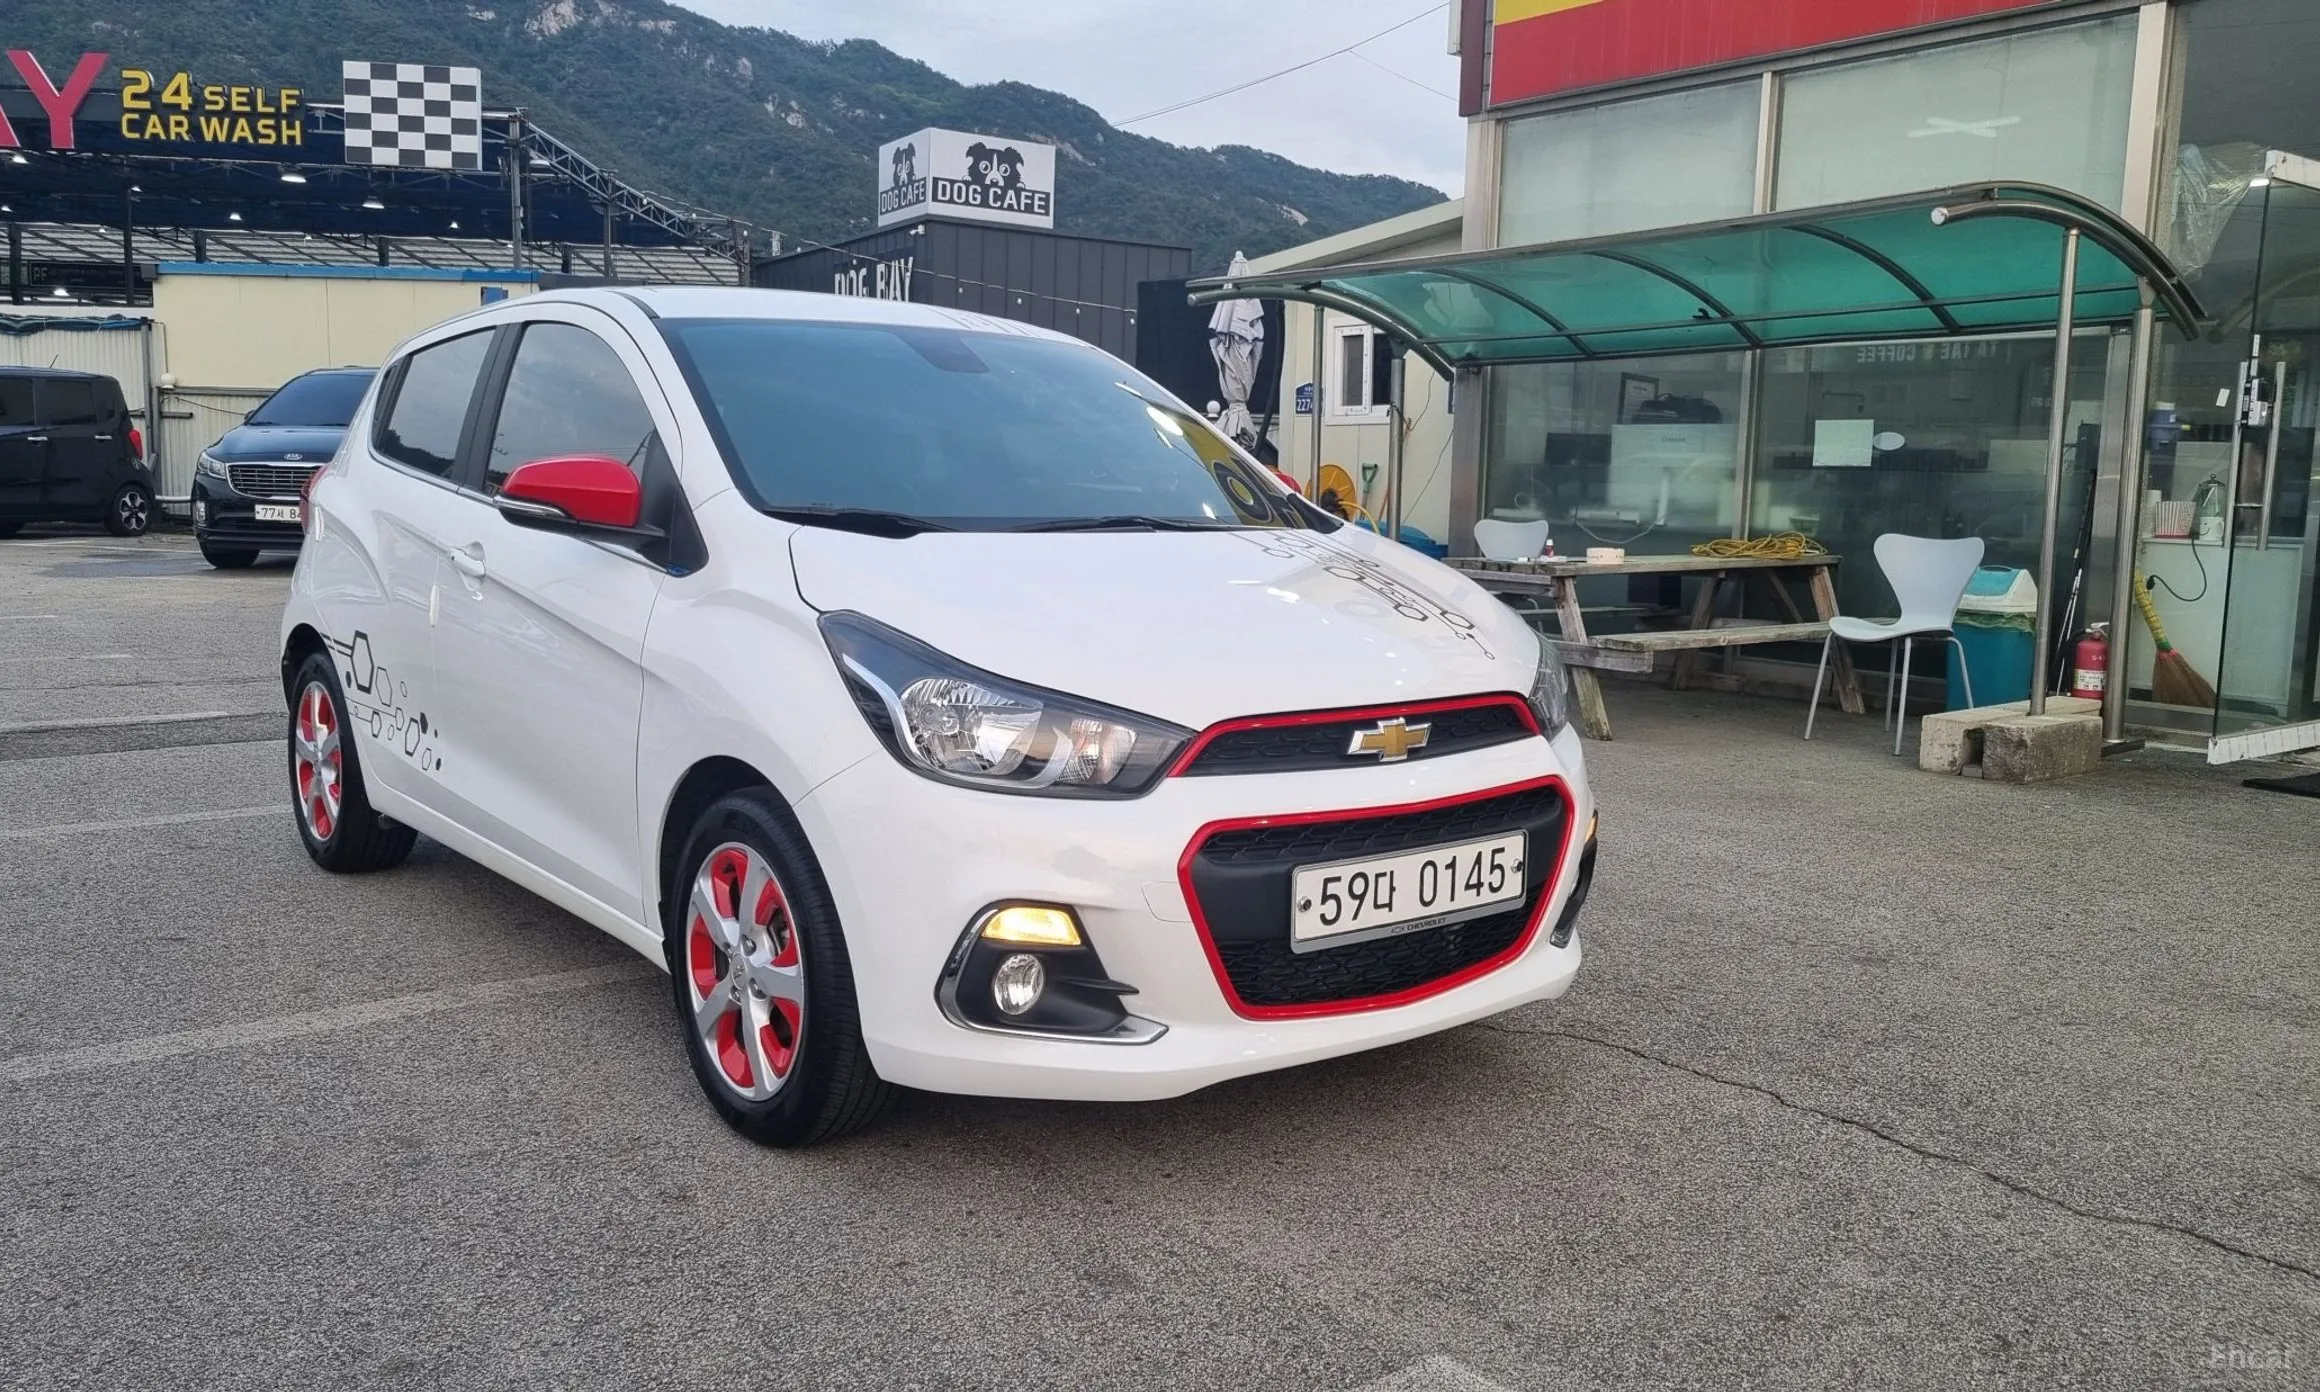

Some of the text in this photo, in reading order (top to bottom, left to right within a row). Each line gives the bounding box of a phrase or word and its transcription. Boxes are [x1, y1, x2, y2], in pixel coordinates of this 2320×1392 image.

[0, 49, 109, 149] Y
[121, 69, 302, 114] 24 SELF
[121, 114, 302, 145] CAR WASH
[881, 180, 926, 213] DOG CAFE
[937, 180, 1046, 214] DOG CAFE
[876, 256, 914, 303] BAY
[1318, 847, 1507, 926] 59다 0145
[1407, 917, 1447, 931] CHEVROLET
